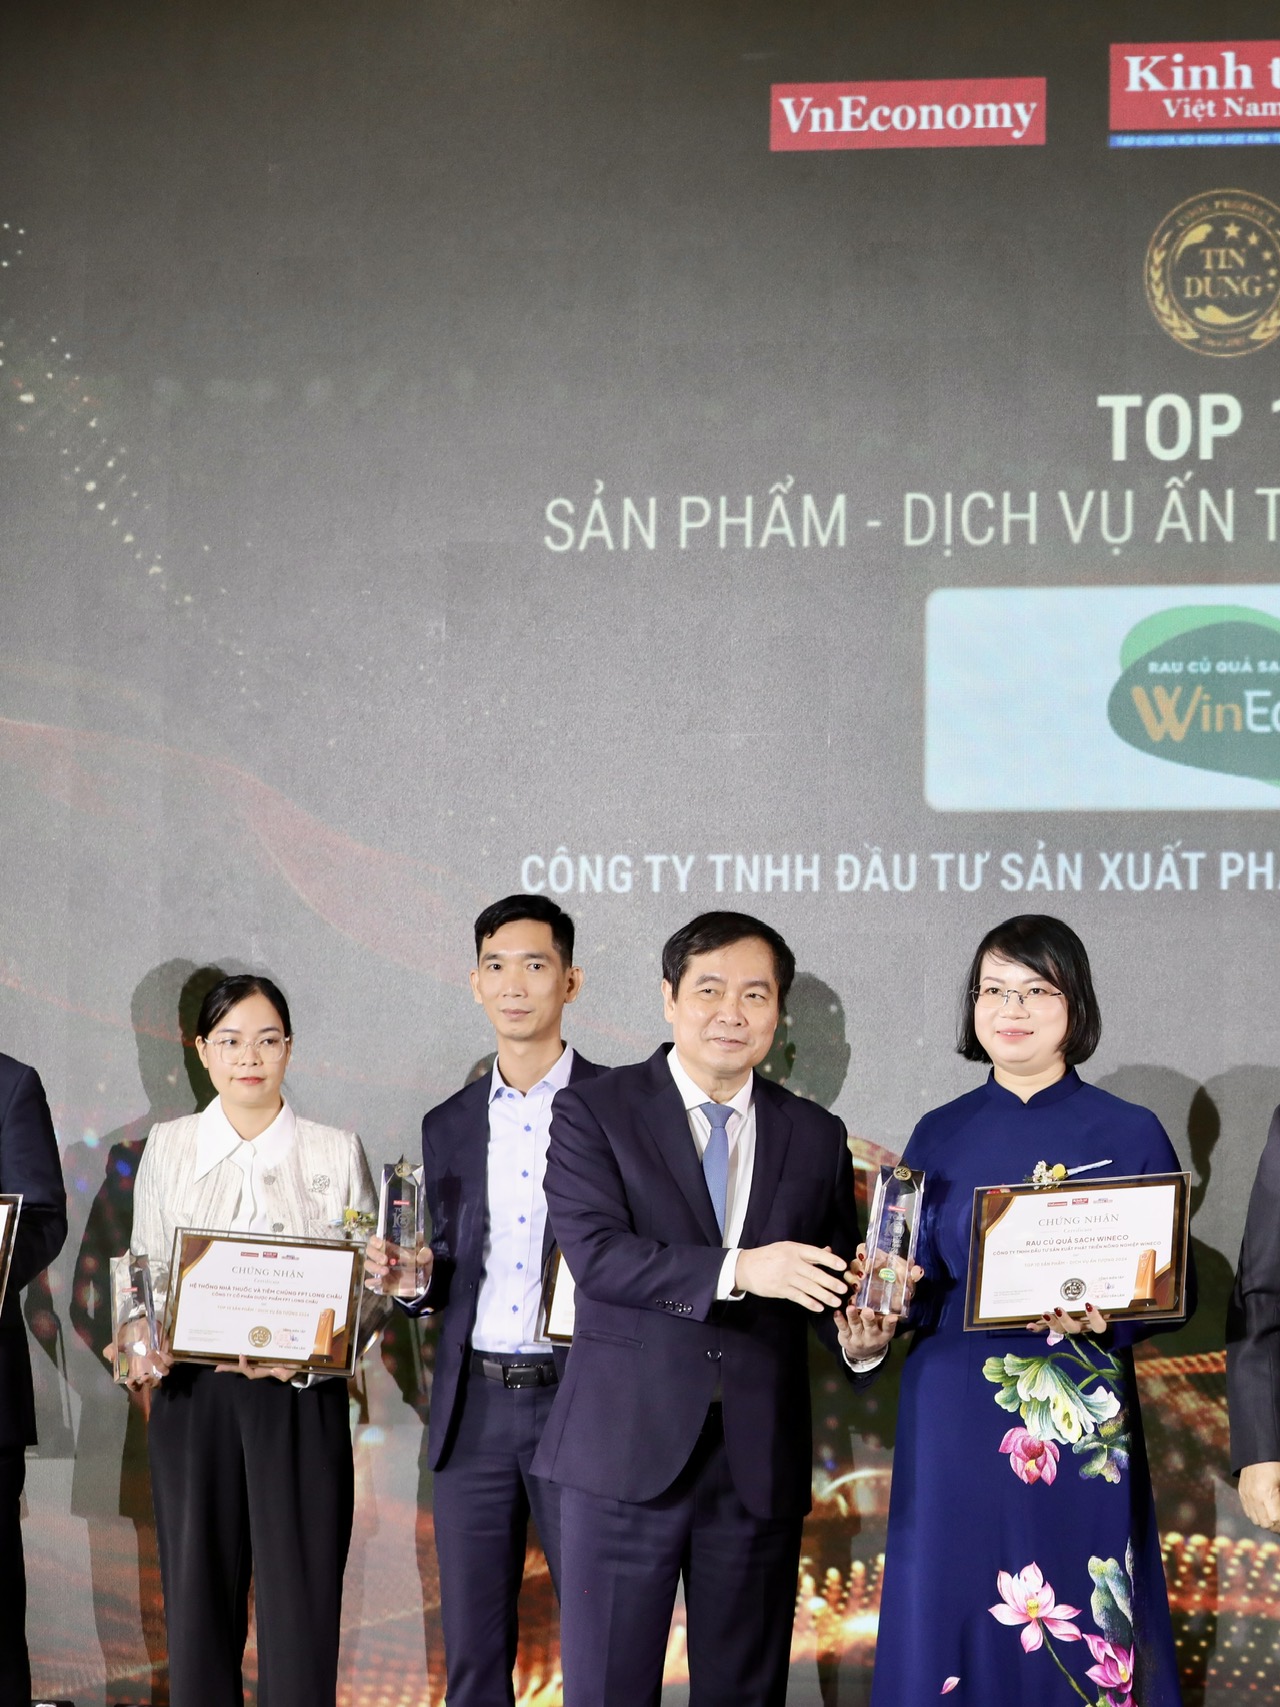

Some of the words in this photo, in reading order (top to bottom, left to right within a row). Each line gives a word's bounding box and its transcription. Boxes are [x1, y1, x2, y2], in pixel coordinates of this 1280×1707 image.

[1124, 51, 1254, 91] Kinh
[779, 96, 1037, 139] VnEconomy
[1162, 97, 1217, 122] Việt
[1200, 248, 1247, 269] TIN
[1097, 393, 1242, 461] TOP
[544, 480, 657, 552] SẢN
[680, 475, 846, 550] PHẨM
[905, 492, 1037, 556] DỊCH
[1058, 489, 1134, 555] VỤ
[1155, 471, 1233, 543] ẤN
[1148, 661, 1183, 673] RAU
[521, 844, 634, 893] CÔNG
[643, 855, 696, 892] TY
[708, 854, 820, 892] TNHH
[835, 842, 917, 892] ĐẦU
[931, 851, 991, 891] TƯ
[1000, 840, 1082, 891] SẢN
[1099, 840, 1205, 891] XUẤT
